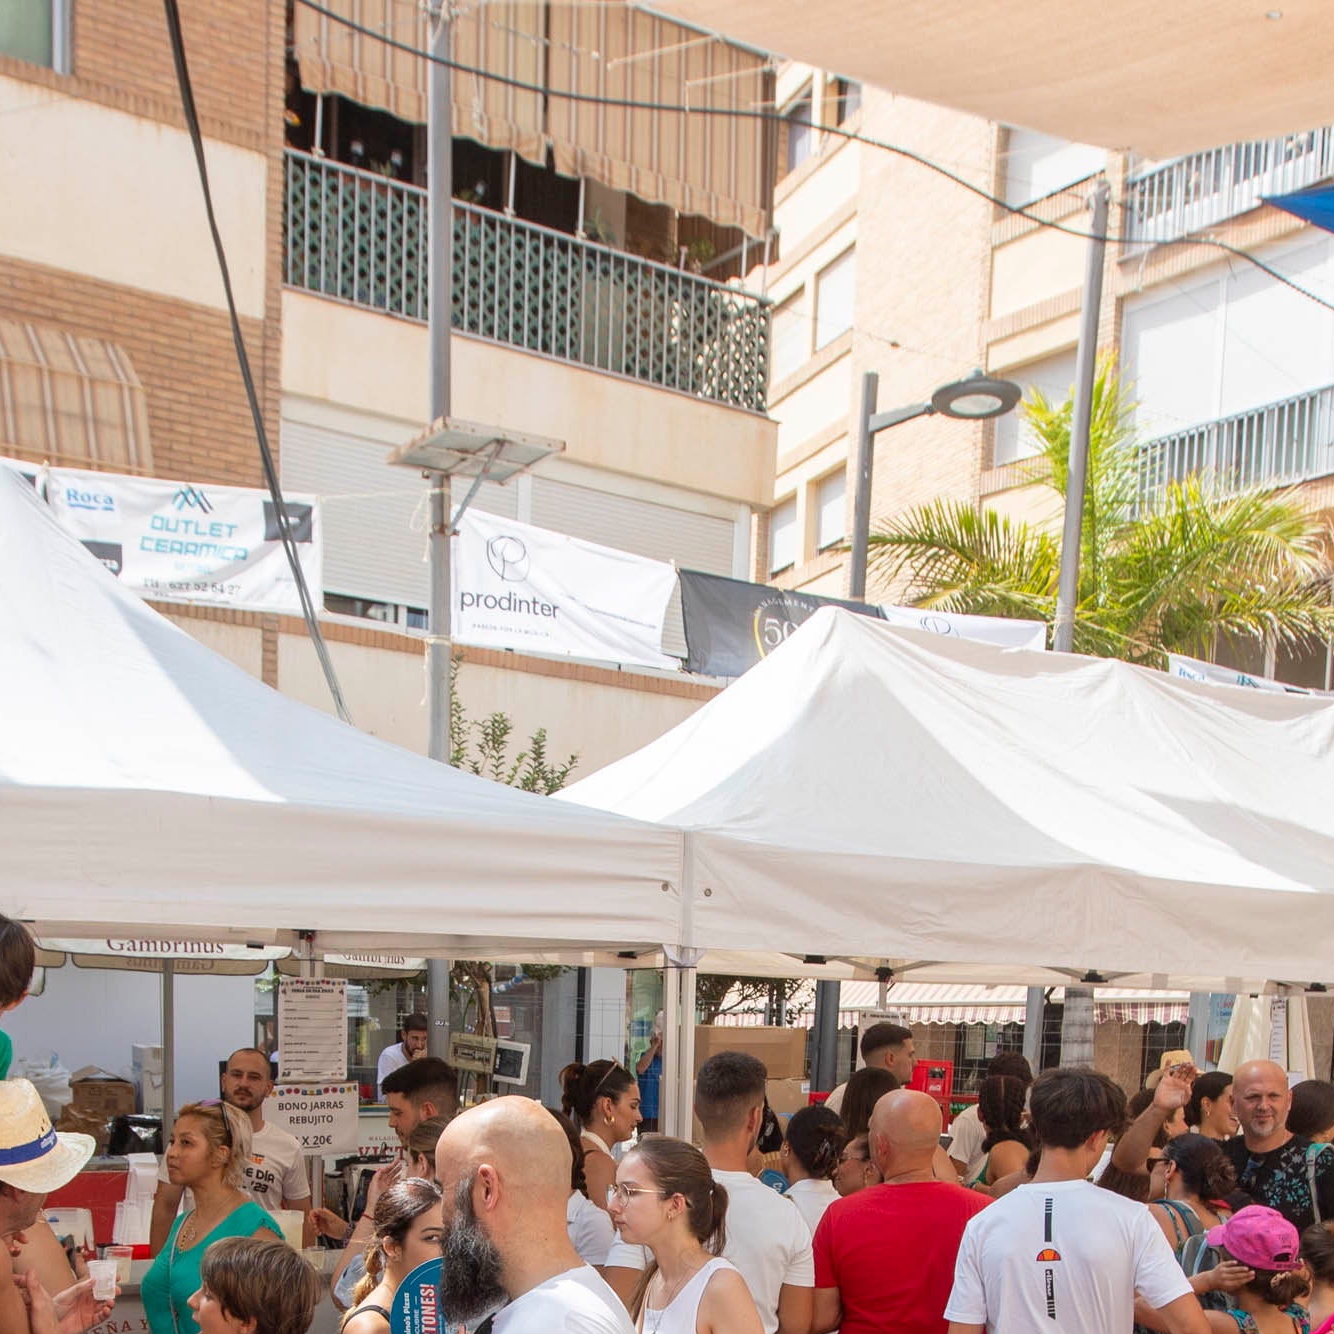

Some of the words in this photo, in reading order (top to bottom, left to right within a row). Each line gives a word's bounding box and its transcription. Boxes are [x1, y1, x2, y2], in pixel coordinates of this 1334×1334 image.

[66, 488, 114, 505] Roca
[150, 514, 240, 539] OUTLET
[139, 535, 249, 562] CERAMICA
[460, 591, 559, 619] prodinter
[278, 1101, 308, 1111] BONO
[310, 1100, 344, 1112] JARRAS
[289, 1114, 334, 1126] REBUJITO
[313, 1135, 333, 1146] 20€
